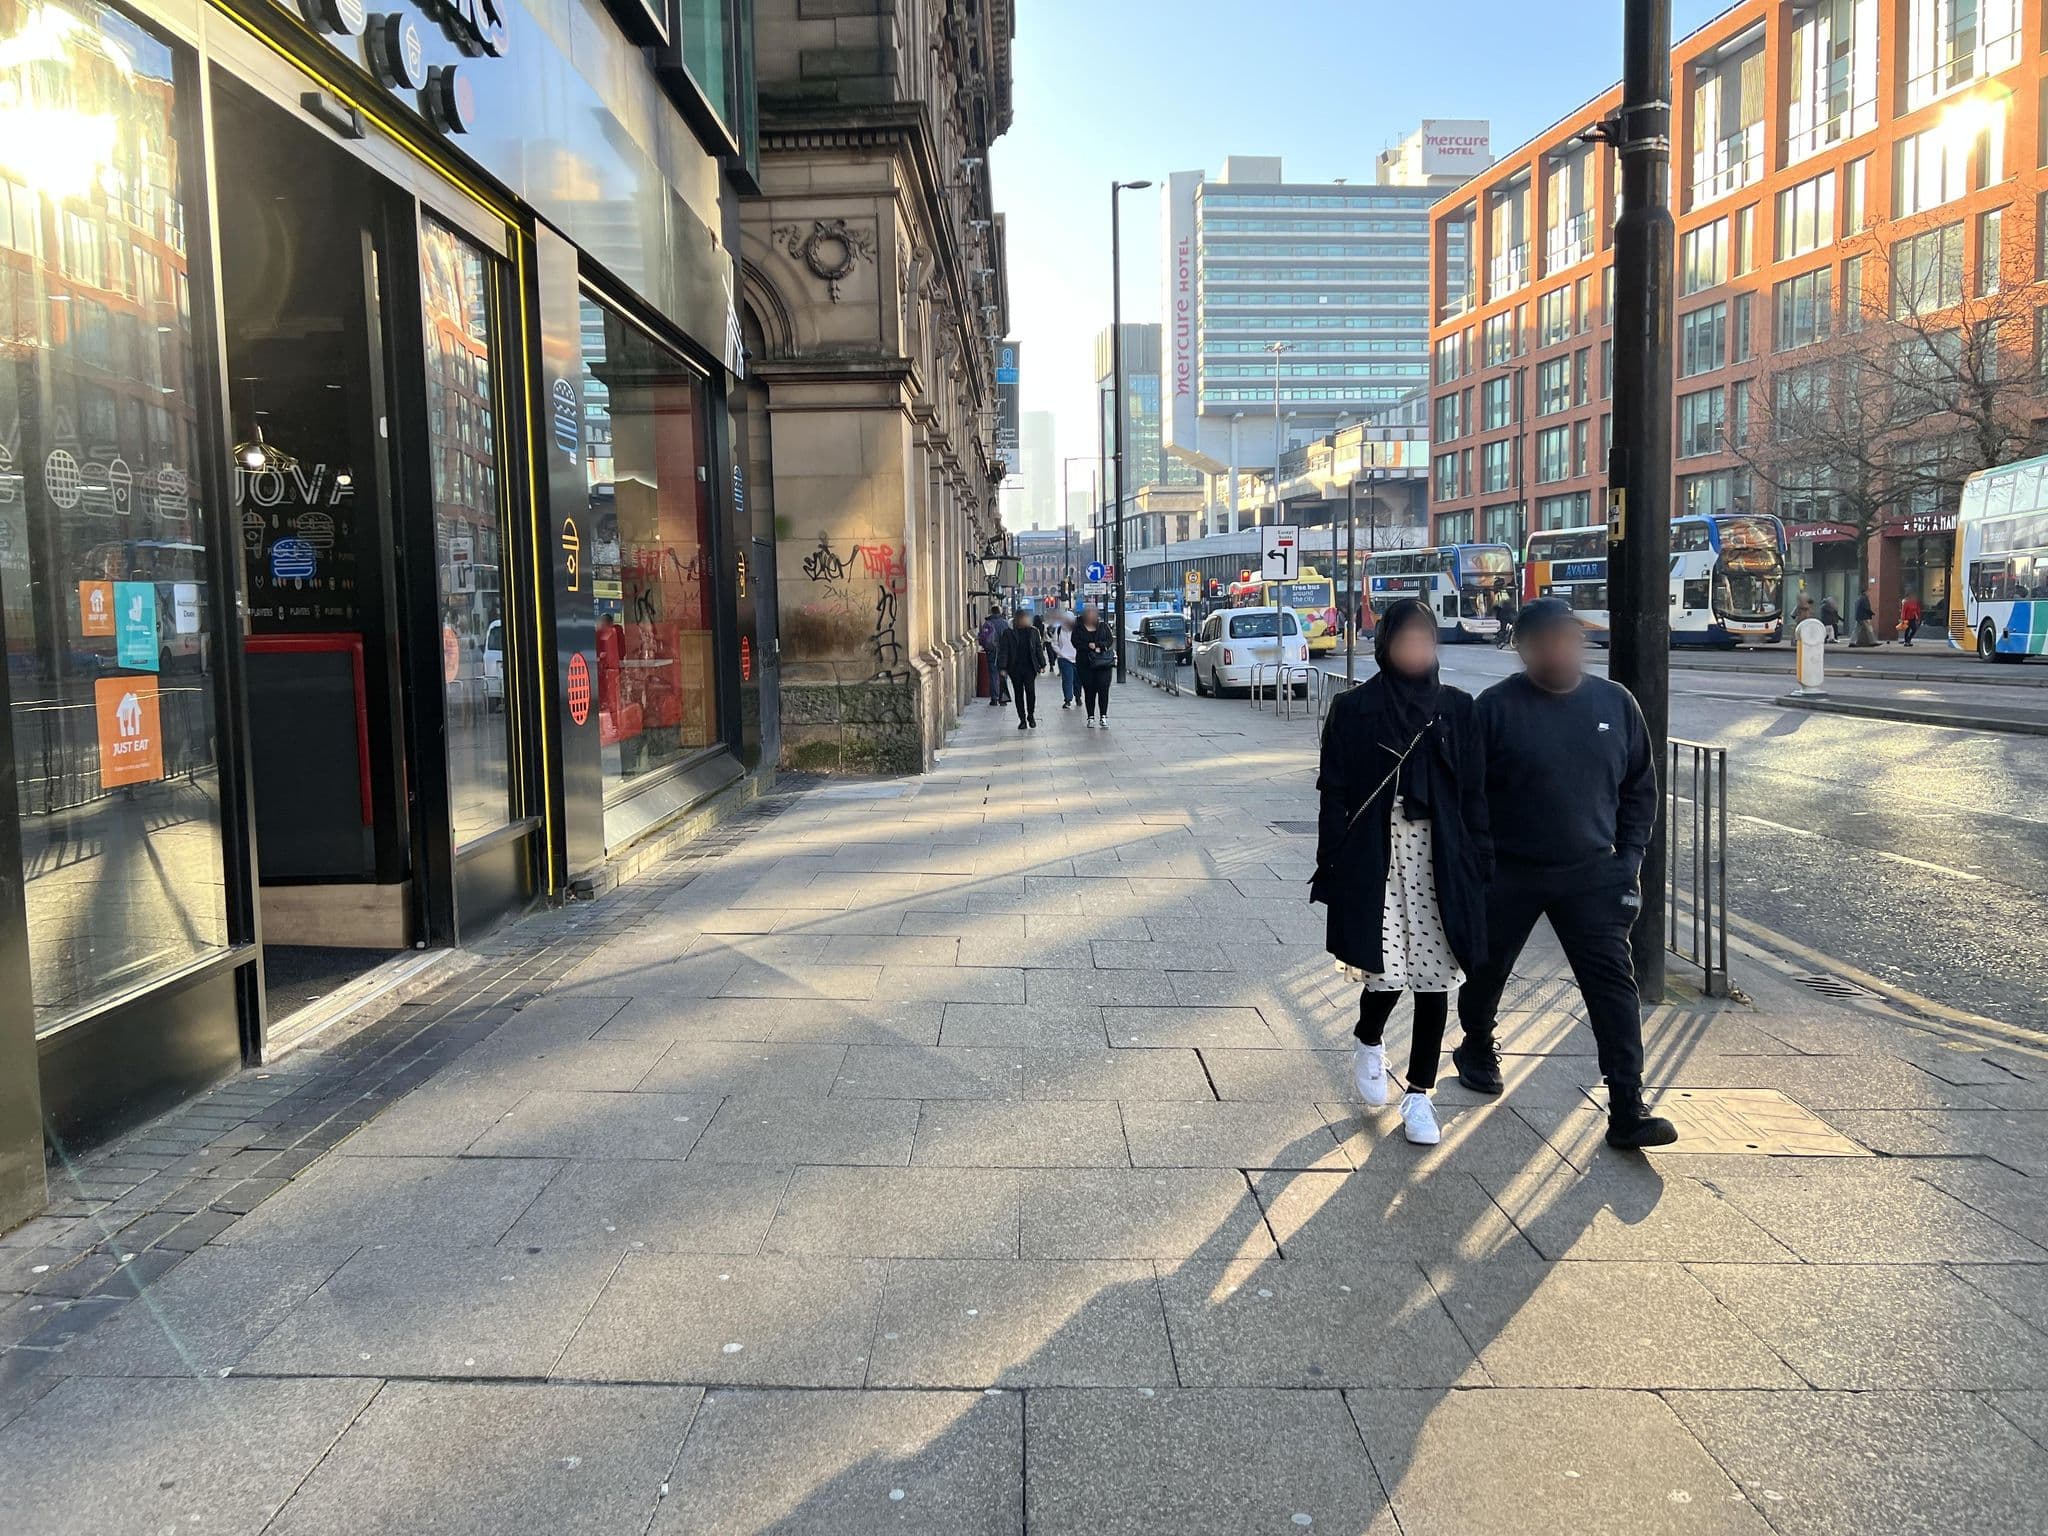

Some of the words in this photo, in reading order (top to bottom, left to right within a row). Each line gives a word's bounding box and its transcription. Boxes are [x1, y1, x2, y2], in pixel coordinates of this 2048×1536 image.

[1438, 147, 1475, 155] HOTEL
[1179, 235, 1189, 292] HOTEL
[1932, 516, 1938, 531] A
[1566, 563, 1598, 577] AVATAR
[112, 741, 133, 757] JUST
[134, 739, 150, 752] EAT
